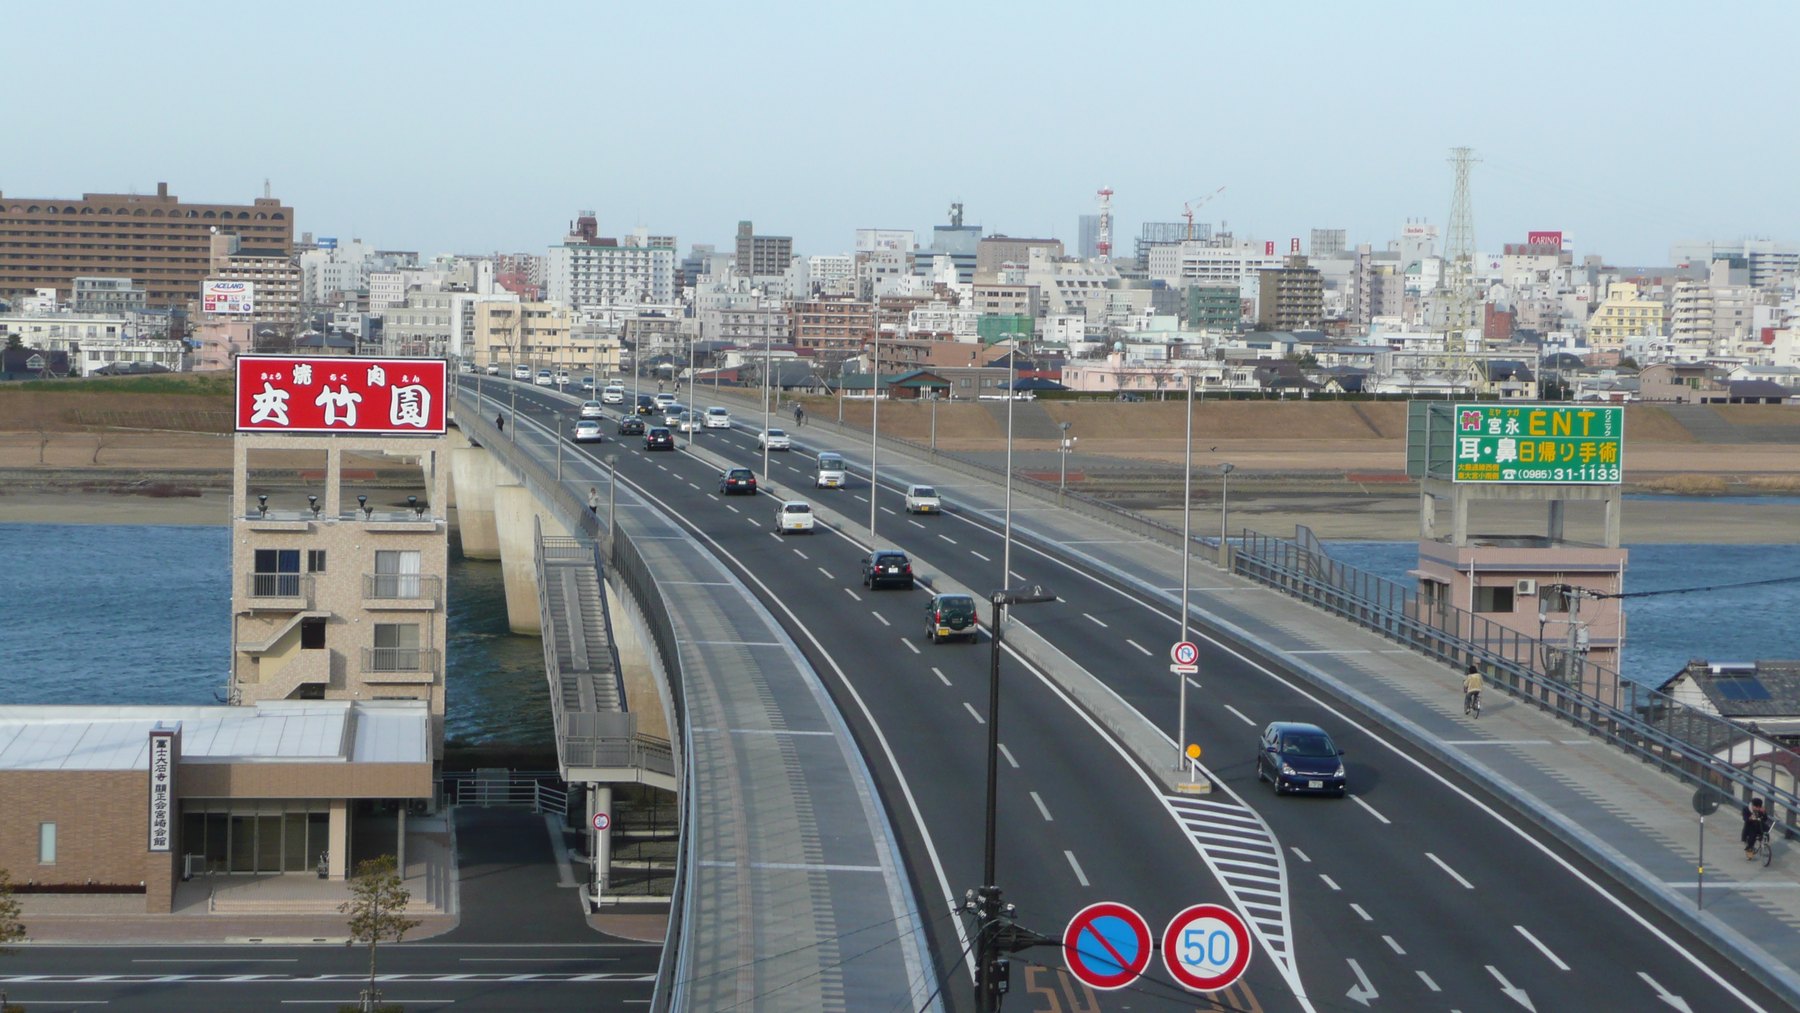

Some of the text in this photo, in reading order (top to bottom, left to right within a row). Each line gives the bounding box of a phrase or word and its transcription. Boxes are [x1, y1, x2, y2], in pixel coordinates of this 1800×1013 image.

[293, 363, 386, 386] 焼肉
[1488, 411, 1595, 436] 宮永 ENT
[1519, 441, 1617, 463] 日帰り手術
[1554, 468, 1619, 480] 31-1133
[1184, 929, 1230, 966] 50
